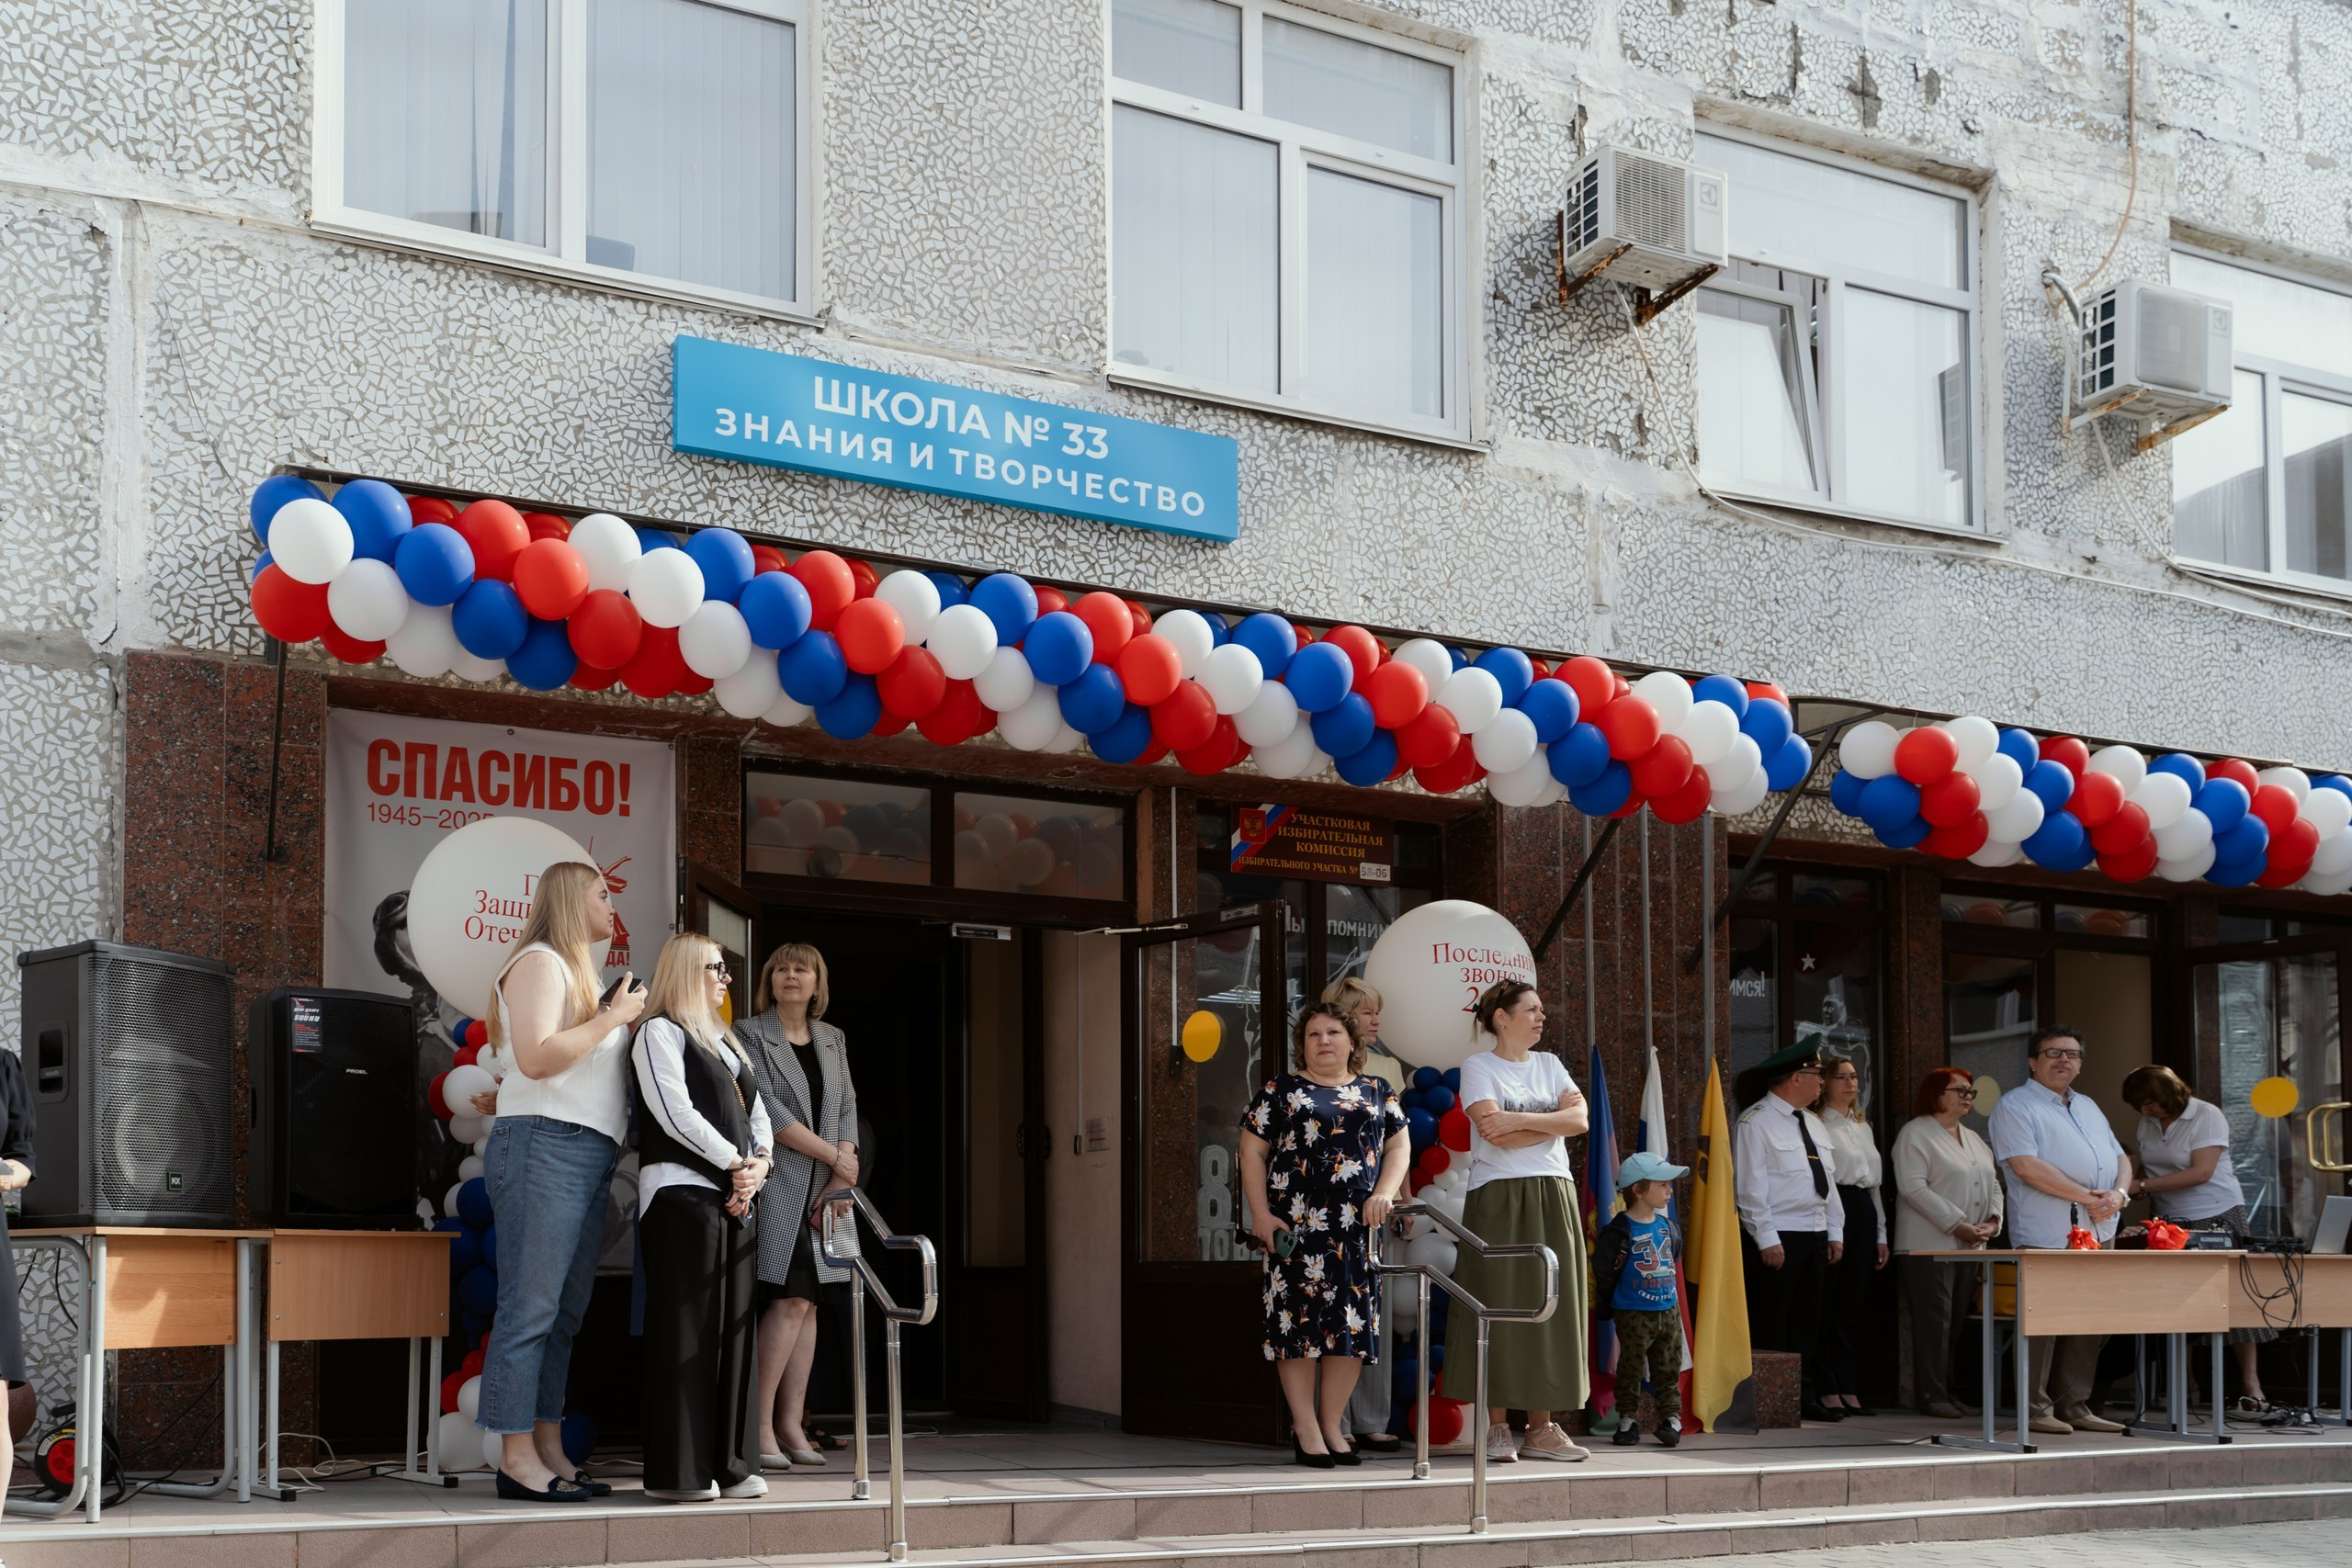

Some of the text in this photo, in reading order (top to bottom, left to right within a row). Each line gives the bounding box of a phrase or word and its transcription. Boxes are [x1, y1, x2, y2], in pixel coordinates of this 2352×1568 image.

[814, 376, 1109, 460] ШКОЛА № 33
[715, 407, 1206, 518] ЗНАНИЯ И ТВОРЧЕСТВО
[367, 738, 631, 818] СПАСИБО!
[1292, 814, 1370, 831] УЧАСТКОВАЯ
[1278, 826, 1384, 846] ИЗБИРАТЕЛЬНАЯ
[1295, 841, 1366, 858] КОМИССИЯ
[1238, 855, 1310, 871] ИЗБИРАТЕЛЬНОГО
[1312, 863, 1347, 874] УЧАСТКА
[1431, 942, 1535, 974] Последний
[1460, 967, 1526, 984] звонок
